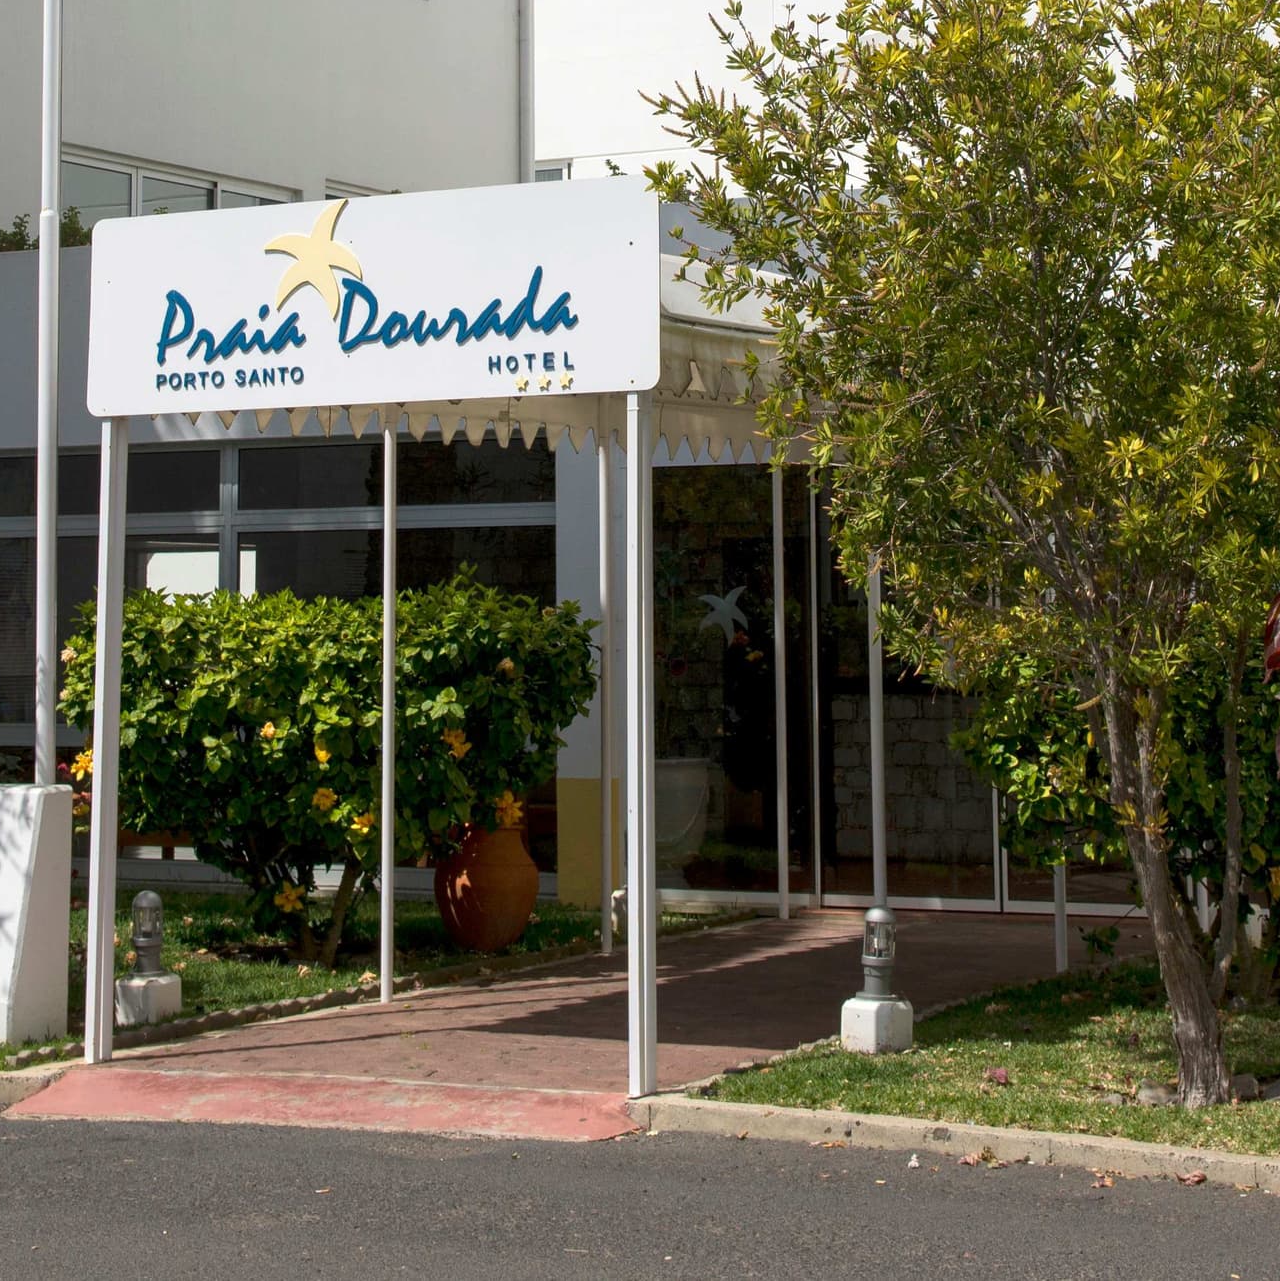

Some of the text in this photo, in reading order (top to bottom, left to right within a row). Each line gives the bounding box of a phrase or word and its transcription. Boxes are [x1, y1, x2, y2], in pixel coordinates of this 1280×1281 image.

[156, 265, 579, 366] Praia Dourada
[488, 351, 576, 375] HOTEL
[156, 365, 306, 391] PORTO SANTO
